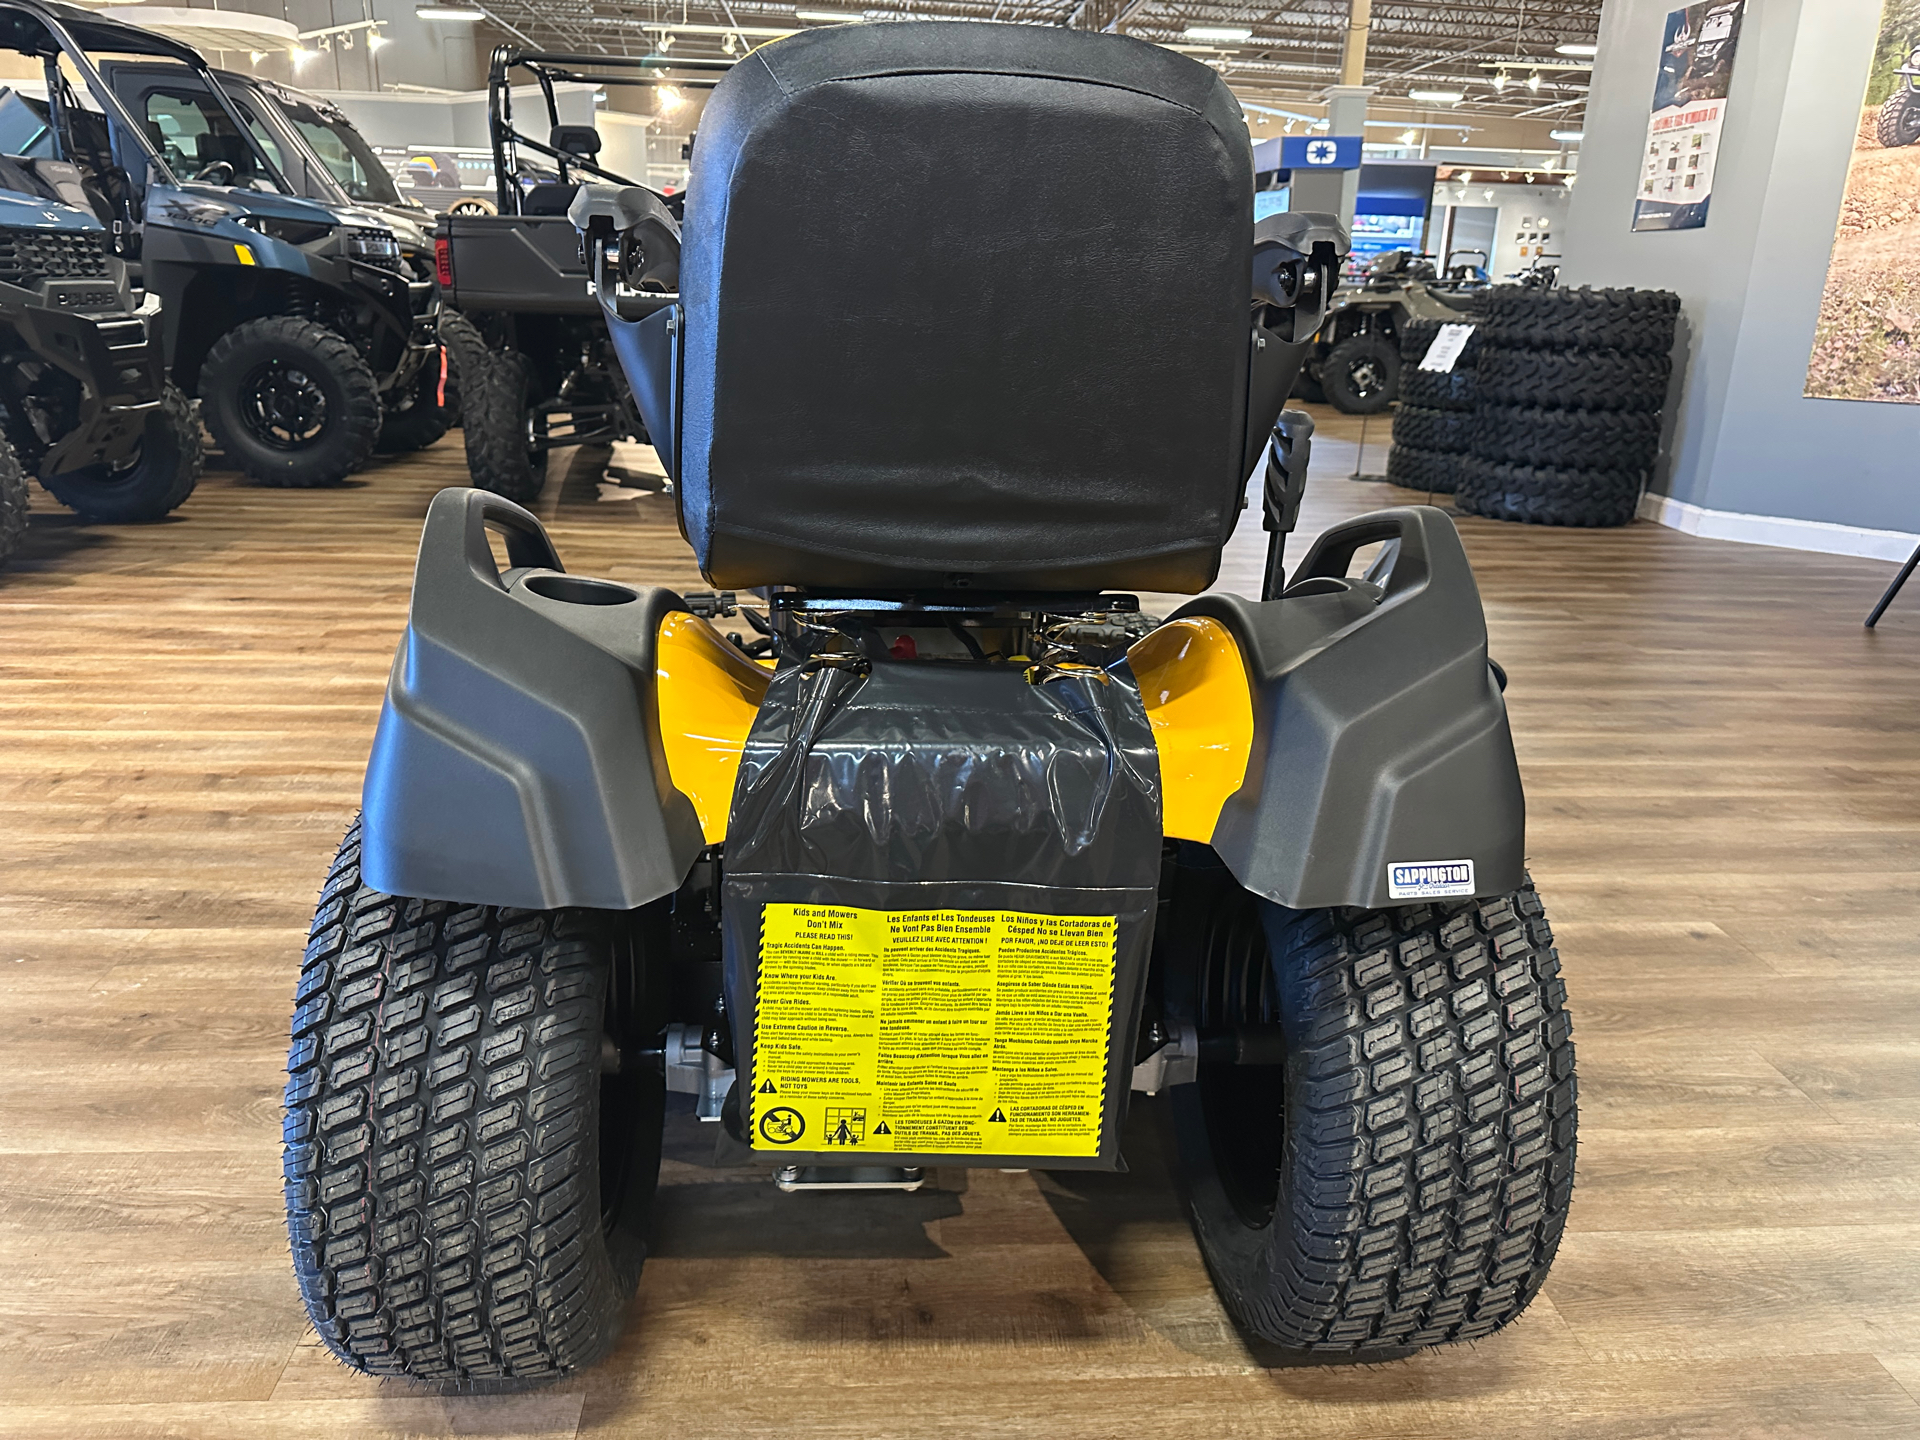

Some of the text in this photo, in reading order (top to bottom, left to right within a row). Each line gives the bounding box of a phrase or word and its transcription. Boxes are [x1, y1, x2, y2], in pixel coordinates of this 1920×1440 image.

[1395, 865, 1468, 884] SAPPINGTON
[793, 908, 858, 919] Kids and Mowers
[887, 915, 901, 923] Les
[902, 914, 930, 923] Enfants
[941, 913, 954, 922] Les
[957, 914, 995, 923] Tondeuses
[807, 920, 843, 929] Don't Mix
[1001, 914, 1015, 923] Los
[1016, 916, 1038, 925] Niños
[1059, 919, 1100, 928] Cortadoras
[1102, 920, 1112, 928] de
[890, 924, 991, 934] Ne Vont Pas Bien Ensemble
[1008, 925, 1035, 935] Césped
[1037, 925, 1047, 935] No
[1060, 929, 1085, 937] Llevan
[766, 942, 783, 950] Tragic
[823, 944, 845, 952] Happen.
